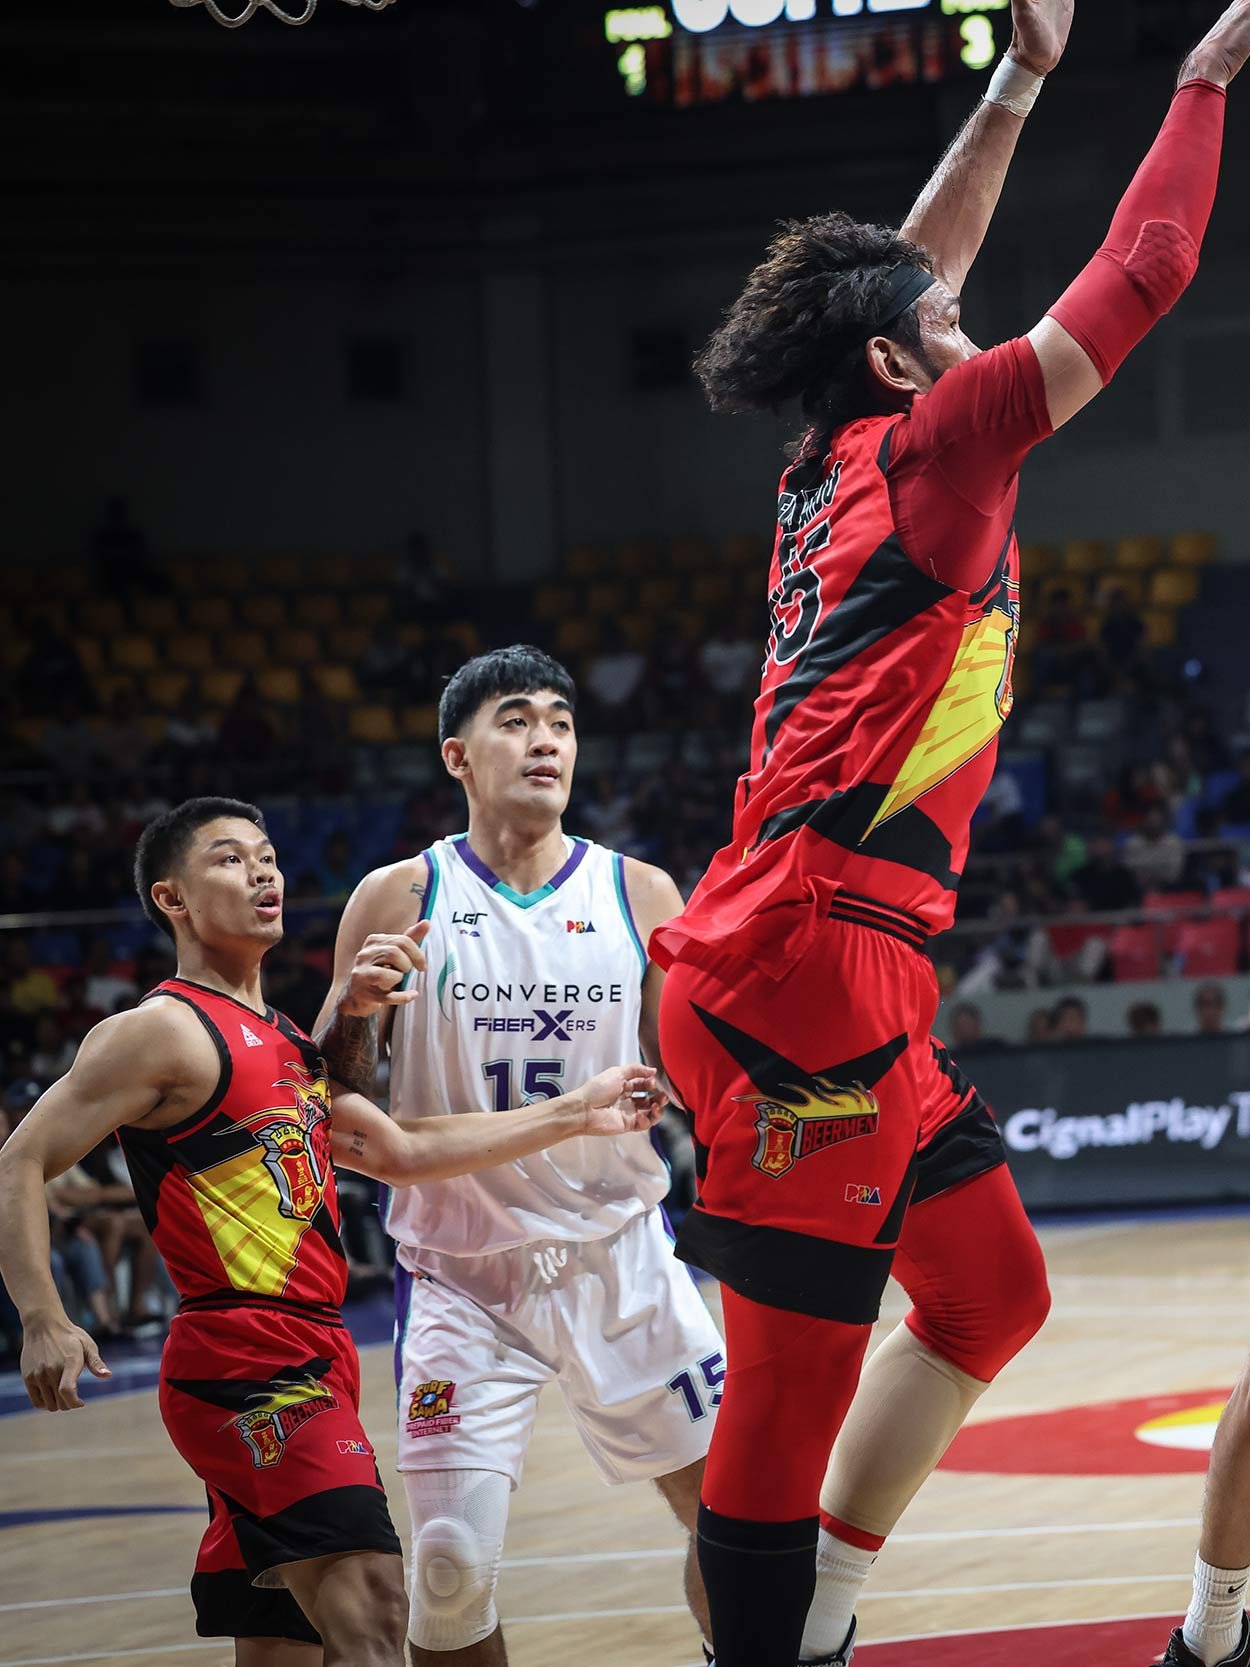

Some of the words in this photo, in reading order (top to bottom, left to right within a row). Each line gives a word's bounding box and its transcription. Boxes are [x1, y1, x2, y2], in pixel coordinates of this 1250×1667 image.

[566, 919, 597, 934] PBA
[452, 983, 622, 1003] CONVERGE
[481, 1058, 566, 1112] 15
[803, 1115, 878, 1151] BEERMEN
[845, 1184, 881, 1205] PBA
[414, 1380, 453, 1402] SURF
[665, 1349, 727, 1423] 15
[408, 1398, 450, 1421] SAWA
